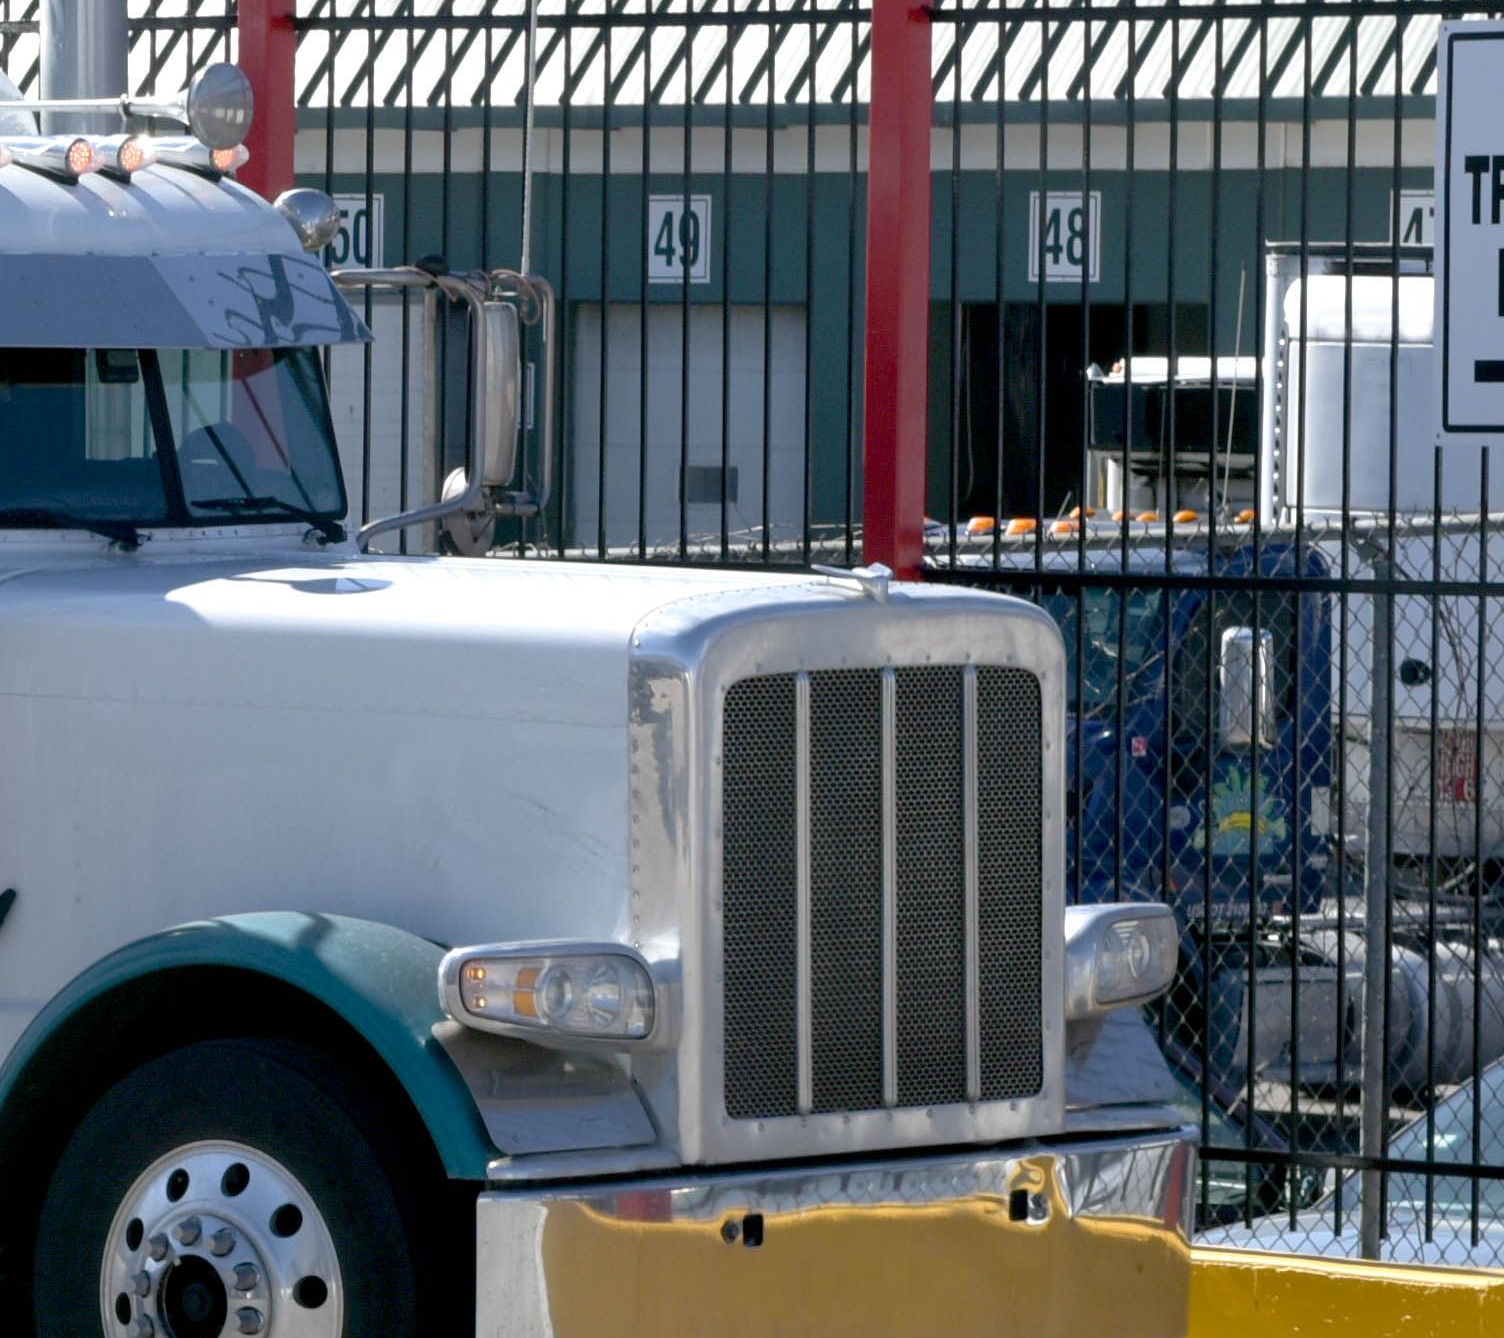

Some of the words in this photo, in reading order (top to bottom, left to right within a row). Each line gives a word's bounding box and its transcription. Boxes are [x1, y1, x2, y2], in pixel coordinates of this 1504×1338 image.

[653, 210, 700, 268] 49
[1040, 207, 1088, 267] 48
[1402, 207, 1434, 245] 4
